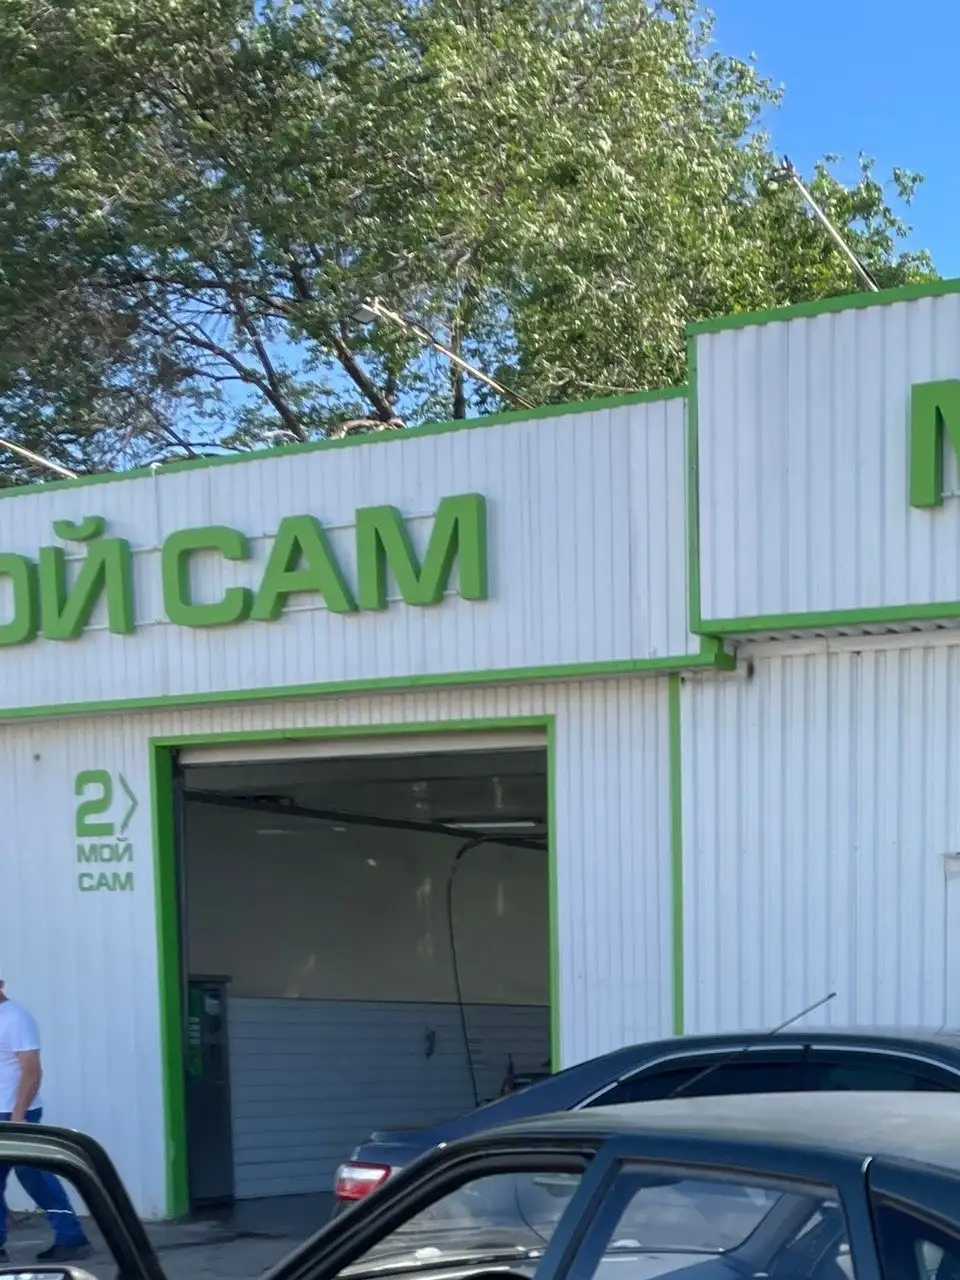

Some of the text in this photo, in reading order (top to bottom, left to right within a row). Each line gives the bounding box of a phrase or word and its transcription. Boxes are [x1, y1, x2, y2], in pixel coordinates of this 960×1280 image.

[161, 493, 488, 628] САМ
[75, 769, 115, 837] 2
[76, 836, 134, 864] МОЙ
[77, 871, 134, 892] САМ
